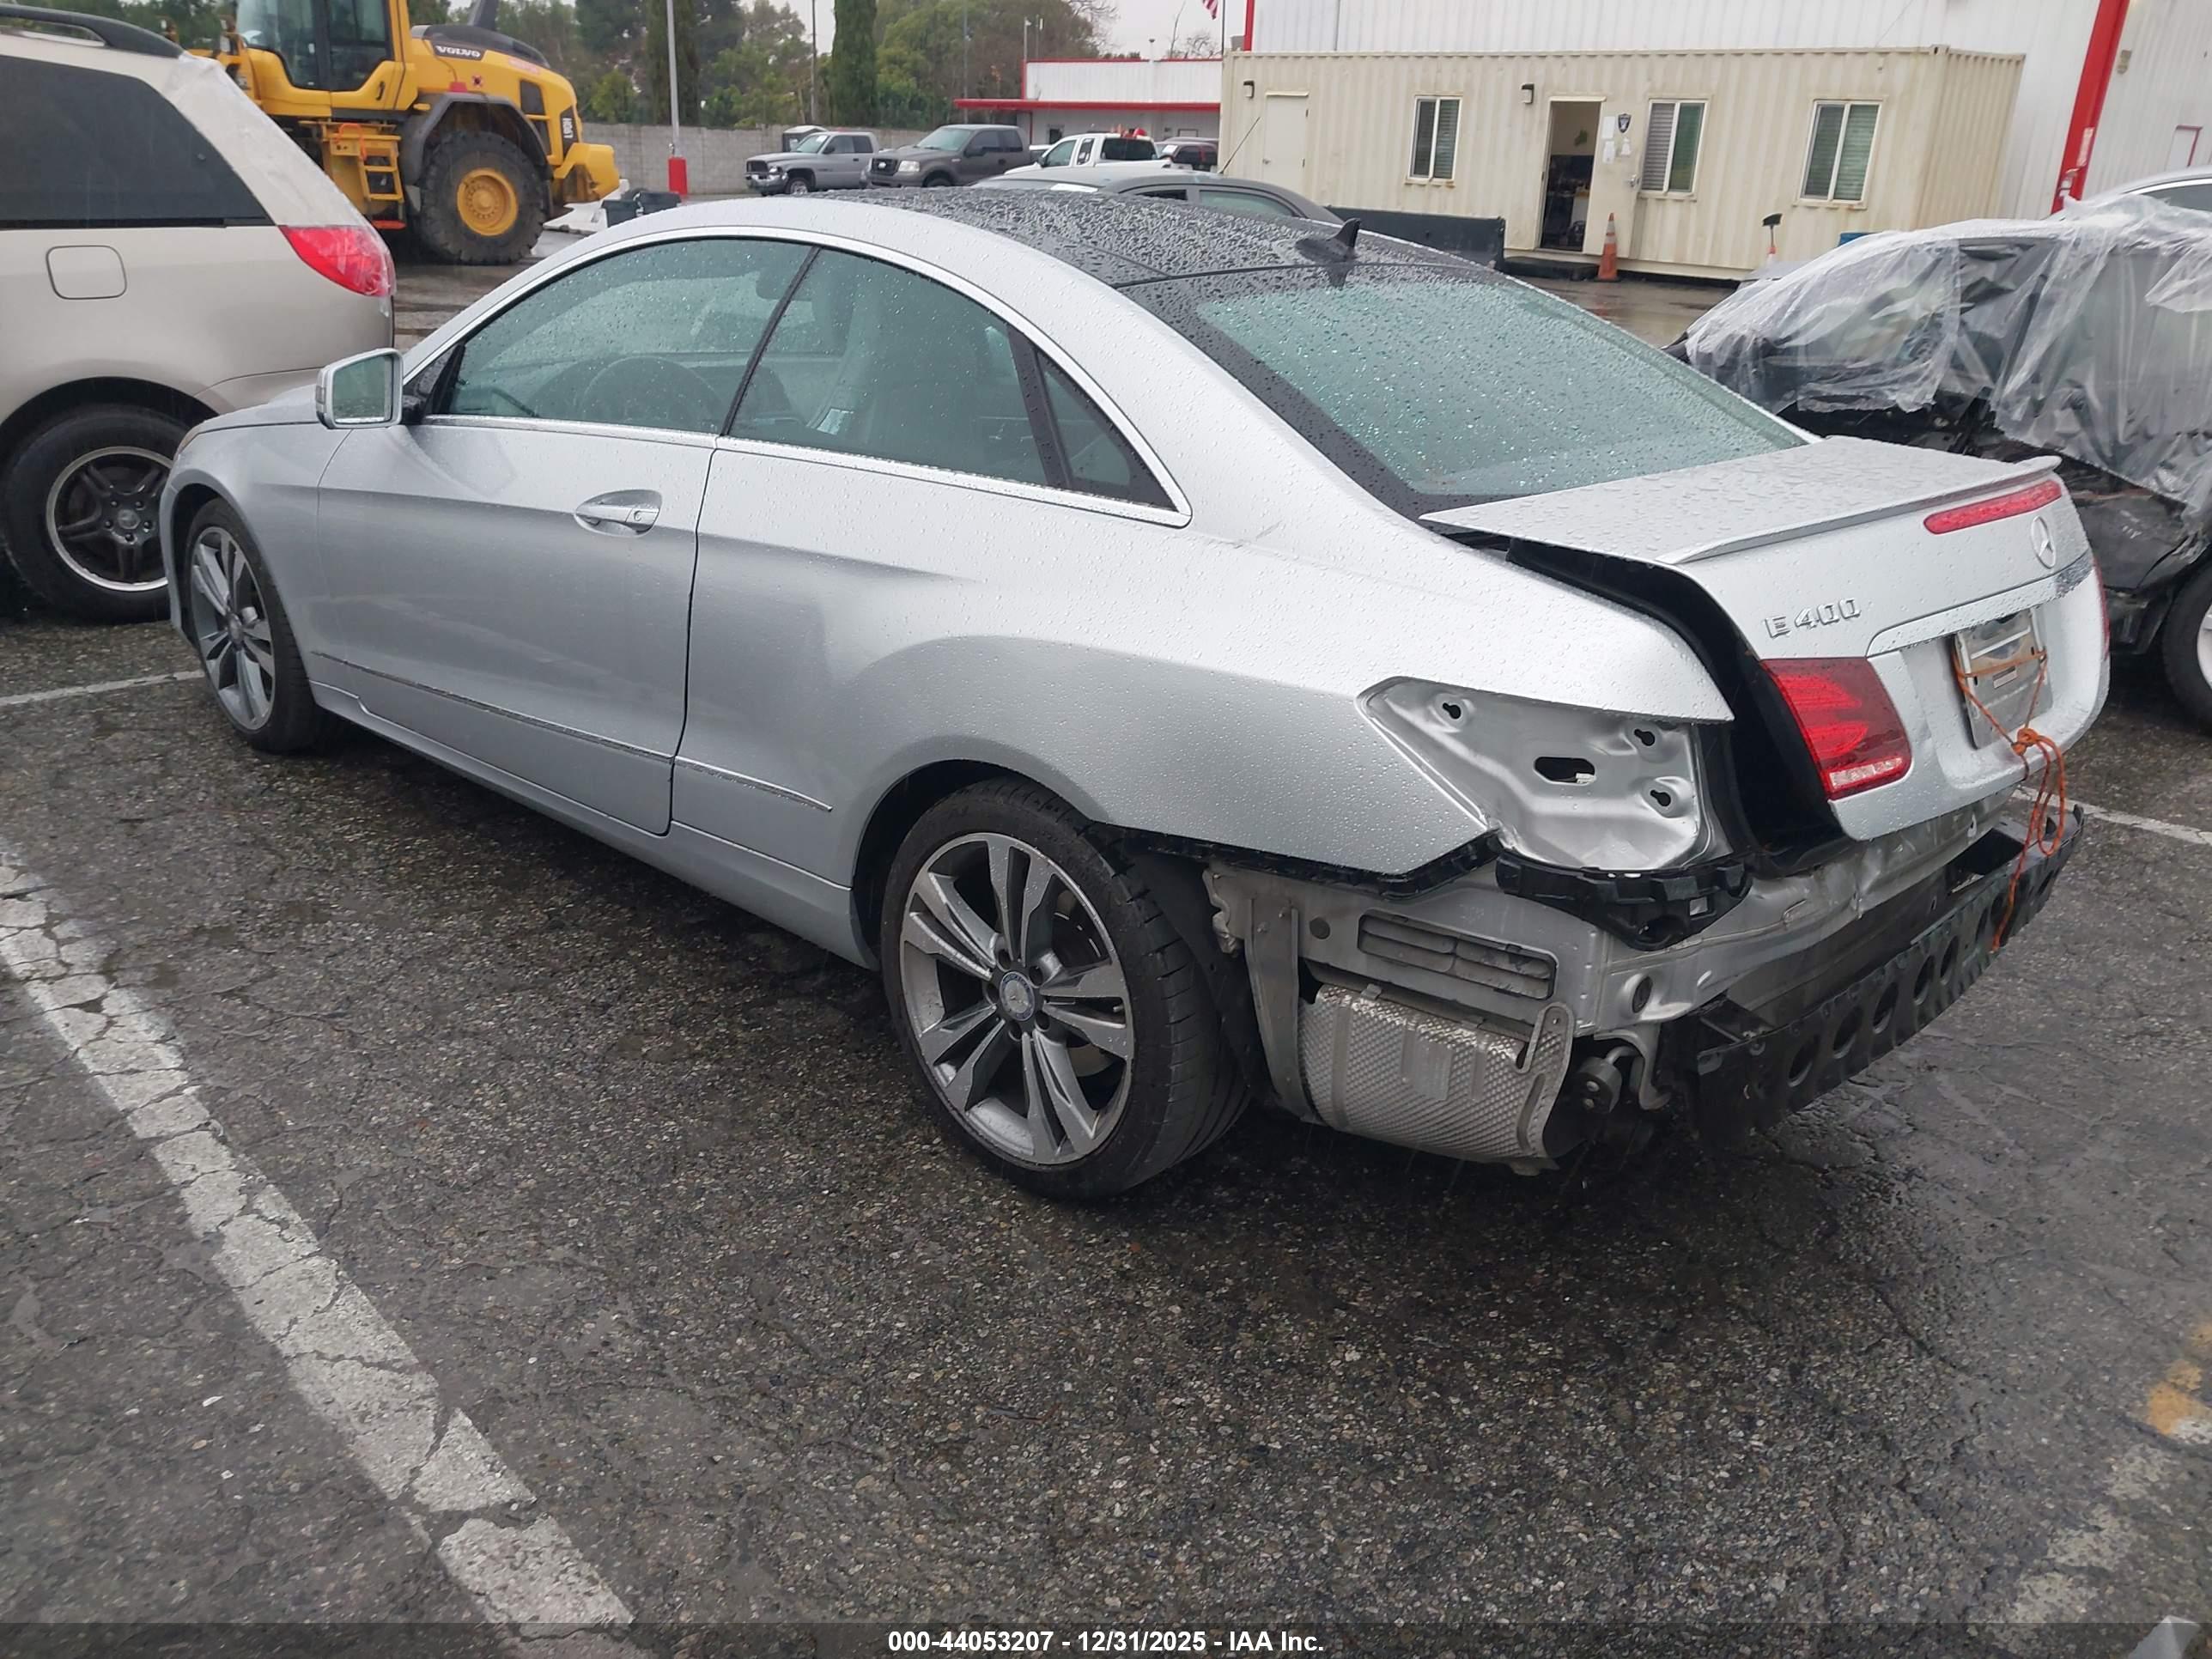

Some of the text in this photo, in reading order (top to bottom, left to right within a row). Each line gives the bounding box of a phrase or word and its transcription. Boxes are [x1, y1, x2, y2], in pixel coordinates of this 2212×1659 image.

[435, 46, 481, 58] VOLVO
[1763, 598, 1862, 639] E 400
